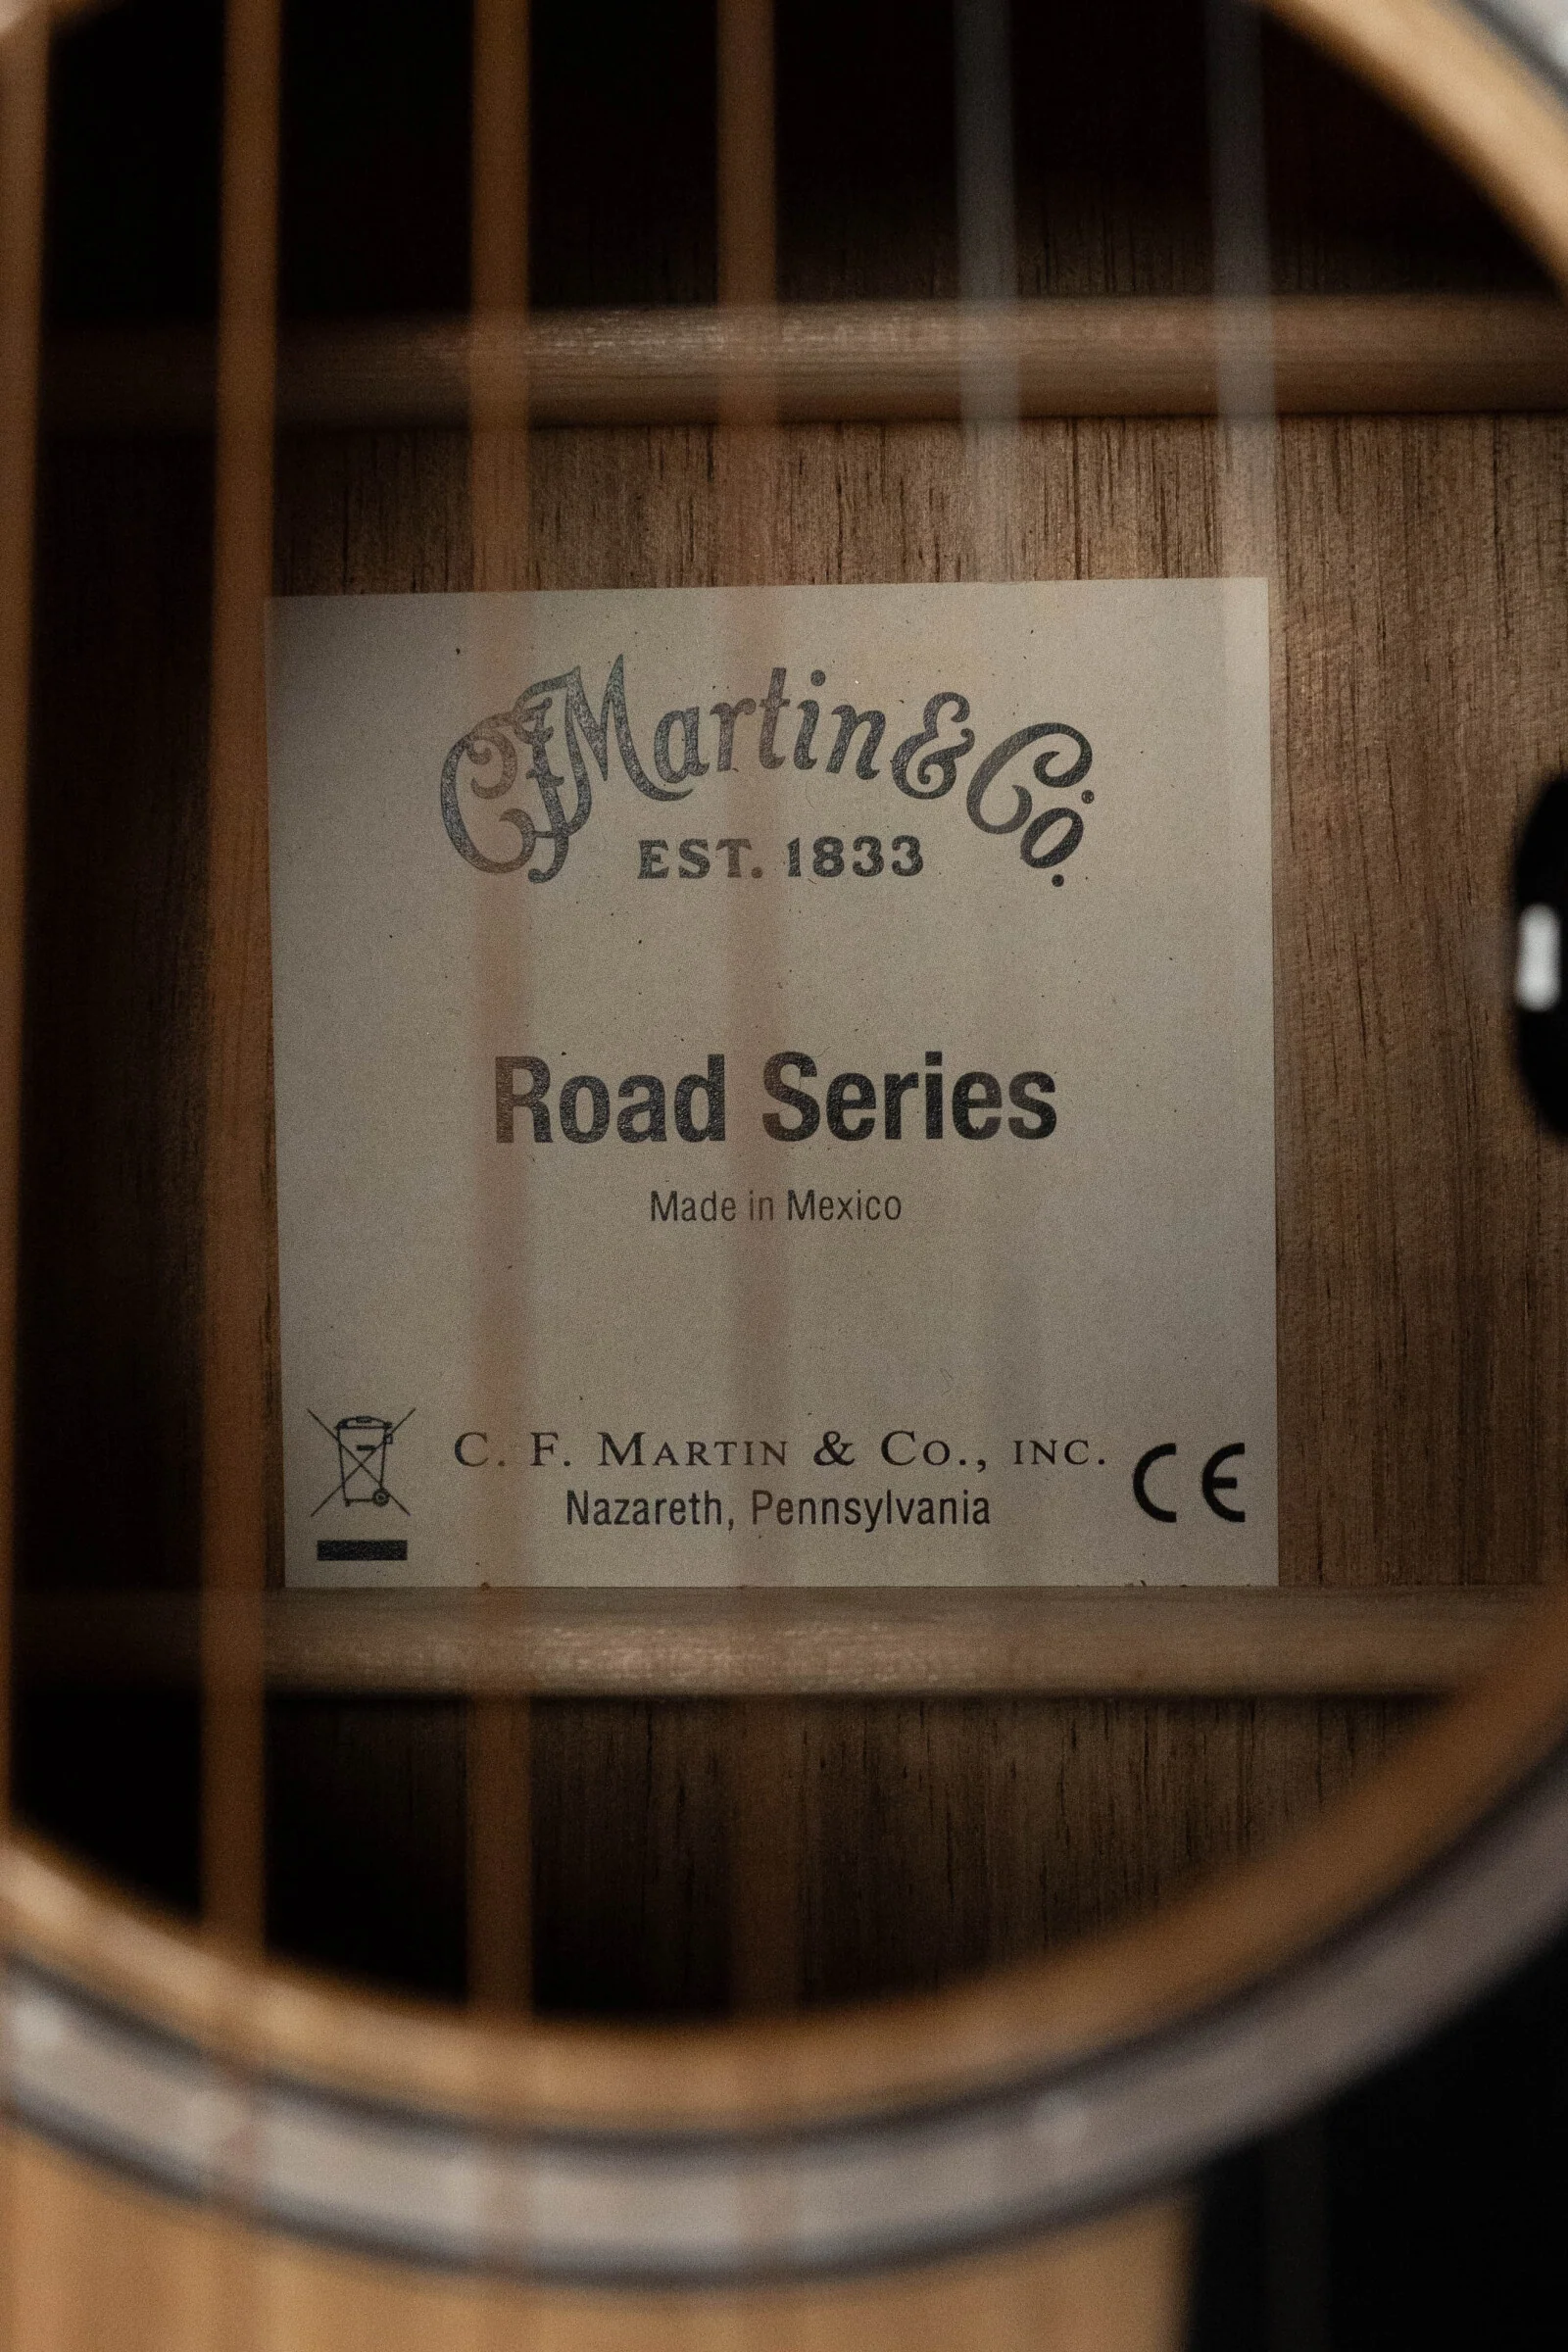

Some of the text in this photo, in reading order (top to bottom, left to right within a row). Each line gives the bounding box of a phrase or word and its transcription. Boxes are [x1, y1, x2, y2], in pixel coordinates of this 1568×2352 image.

[638, 835, 924, 880] EST. 1833
[495, 1051, 1057, 1144] Road Series
[651, 1189, 903, 1222] Made in Mexico
[455, 1431, 506, 1467] C.
[530, 1431, 571, 1467] F.
[813, 1430, 856, 1467] &
[567, 1489, 991, 1534] Nazareth, Pennsylvania
